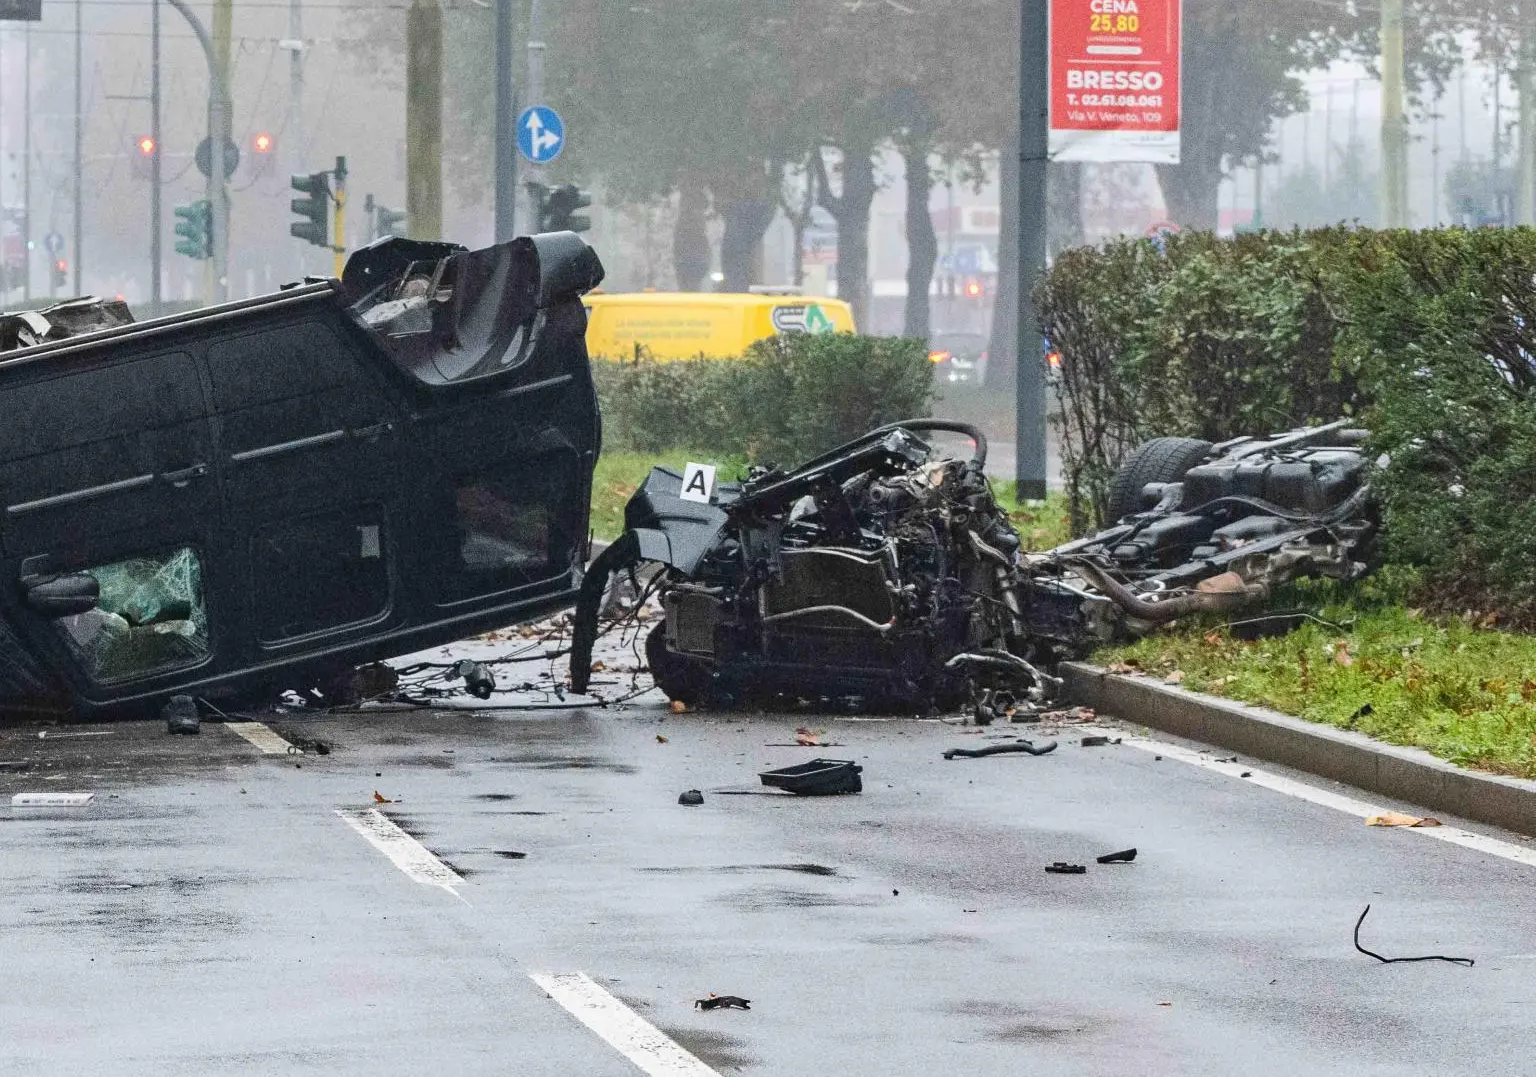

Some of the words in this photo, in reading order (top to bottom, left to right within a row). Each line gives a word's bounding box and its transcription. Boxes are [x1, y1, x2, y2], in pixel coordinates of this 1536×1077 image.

[1090, 0, 1138, 13] CENA
[1090, 15, 1139, 34] 25,80
[1066, 70, 1163, 91] BRESSO
[1066, 94, 1079, 106] T.
[1067, 111, 1085, 122] Via
[684, 469, 707, 496] A
